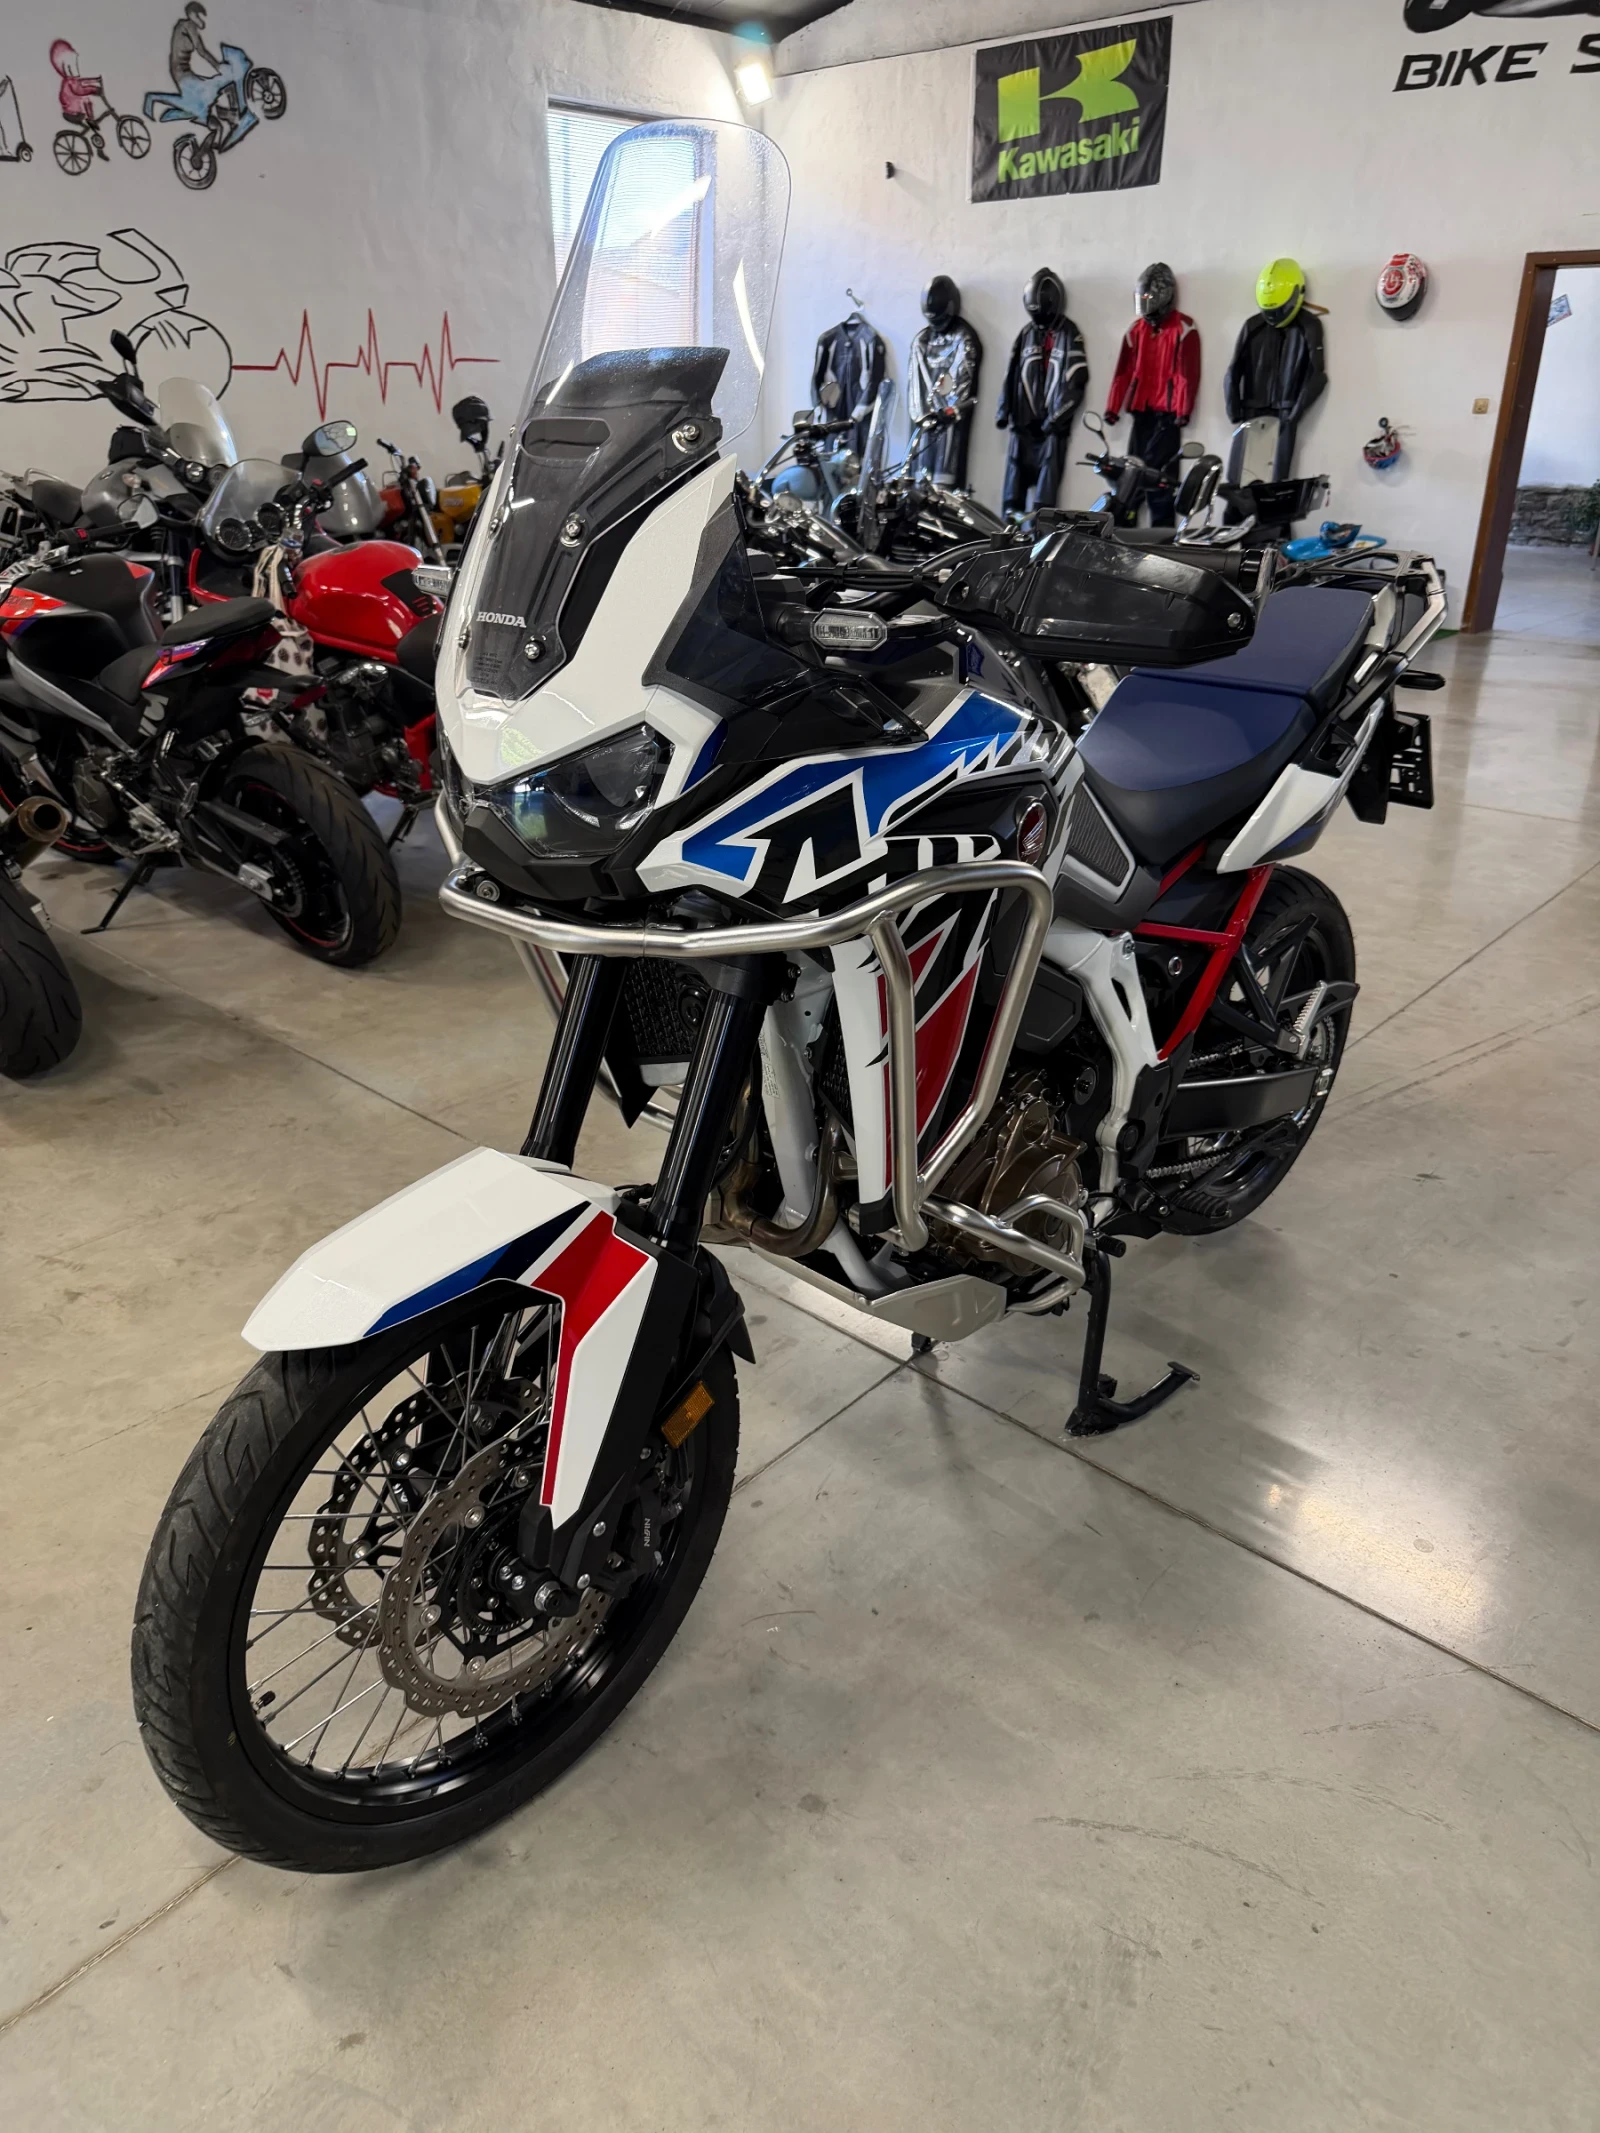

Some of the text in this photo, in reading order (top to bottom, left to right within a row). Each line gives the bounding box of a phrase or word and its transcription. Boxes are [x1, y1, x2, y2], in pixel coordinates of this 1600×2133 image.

[1392, 42, 1549, 92] BIKE
[998, 116, 1140, 184] Kawasaki
[476, 611, 527, 628] HONDA
